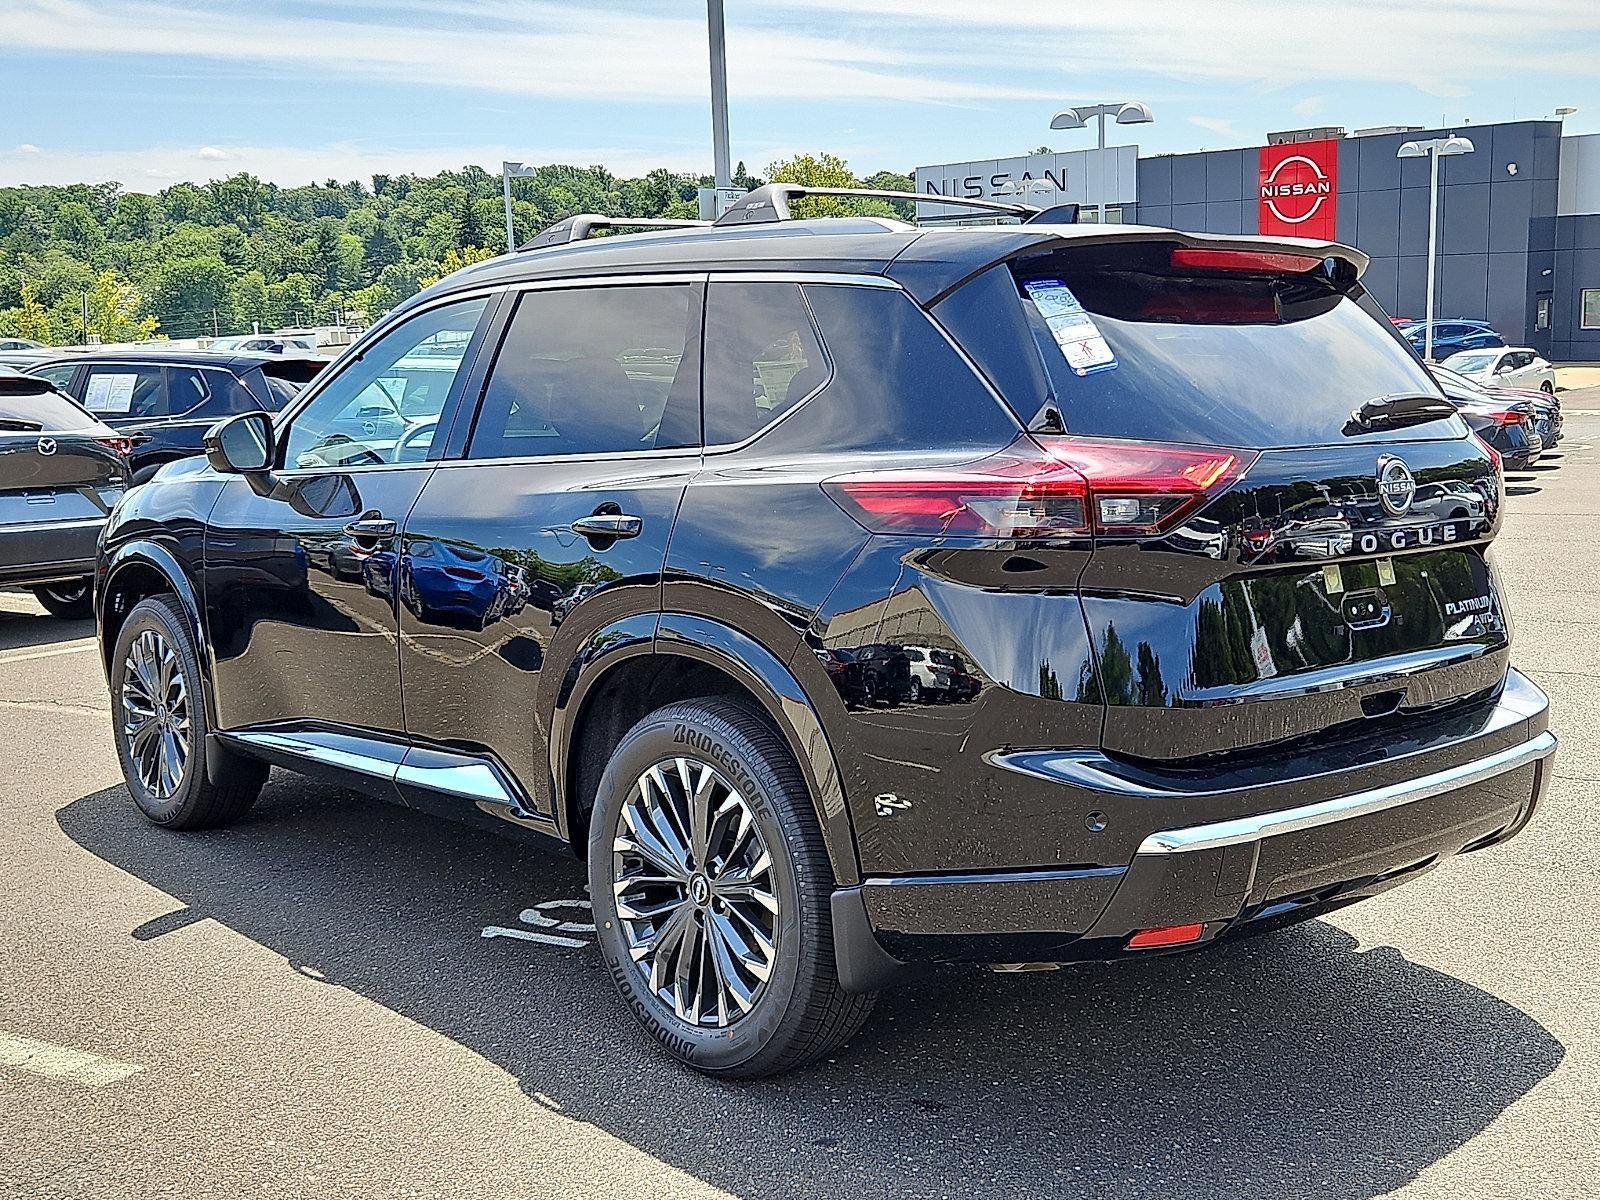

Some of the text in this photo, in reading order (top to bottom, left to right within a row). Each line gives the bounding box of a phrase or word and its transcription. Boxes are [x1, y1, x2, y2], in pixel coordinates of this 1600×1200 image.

[1261, 181, 1330, 198] NISSAN
[1328, 525, 1456, 555] ROGUE
[1445, 595, 1490, 615] PLATINUM
[1474, 611, 1494, 625] AWD
[673, 723, 772, 822] BRIDGESTONE
[609, 955, 697, 1061] BRIDGESTONE
